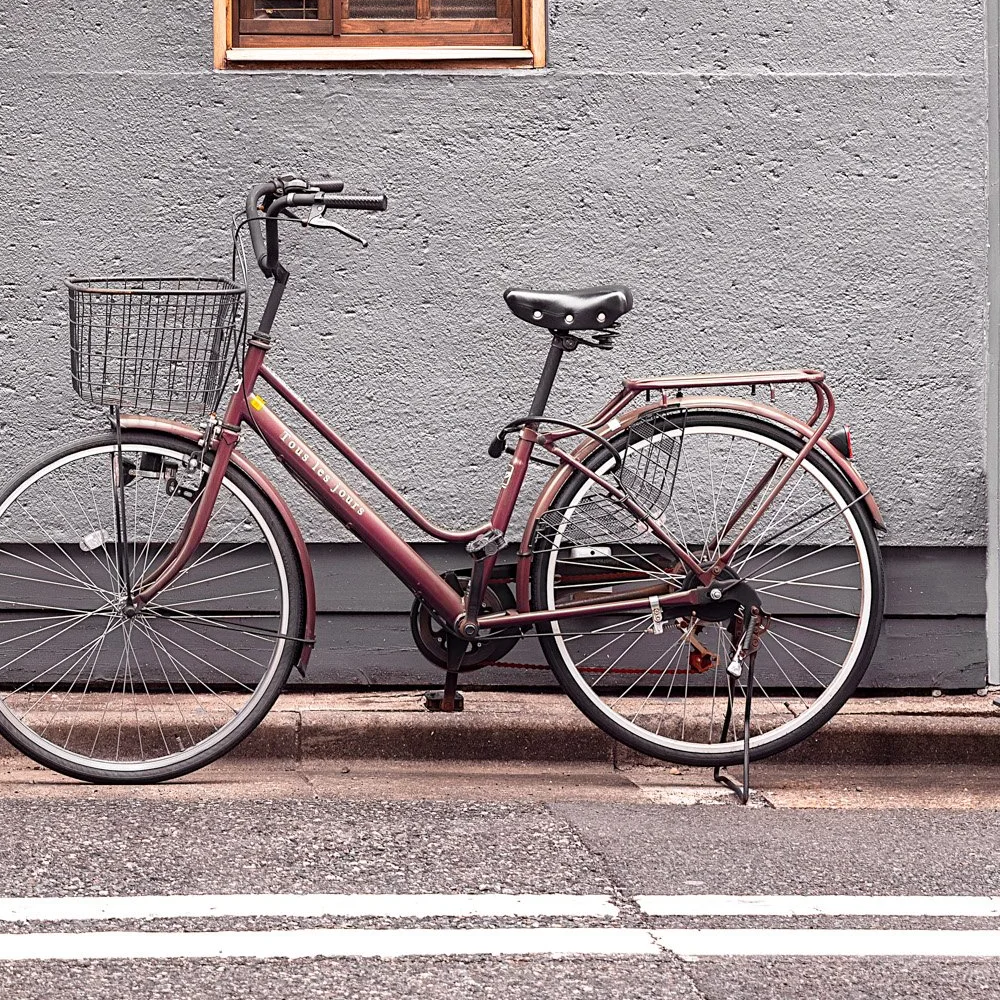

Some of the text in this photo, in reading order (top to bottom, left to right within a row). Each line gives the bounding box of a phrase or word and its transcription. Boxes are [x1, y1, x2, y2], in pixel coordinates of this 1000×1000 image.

[280, 430, 365, 515] Tous les jours
